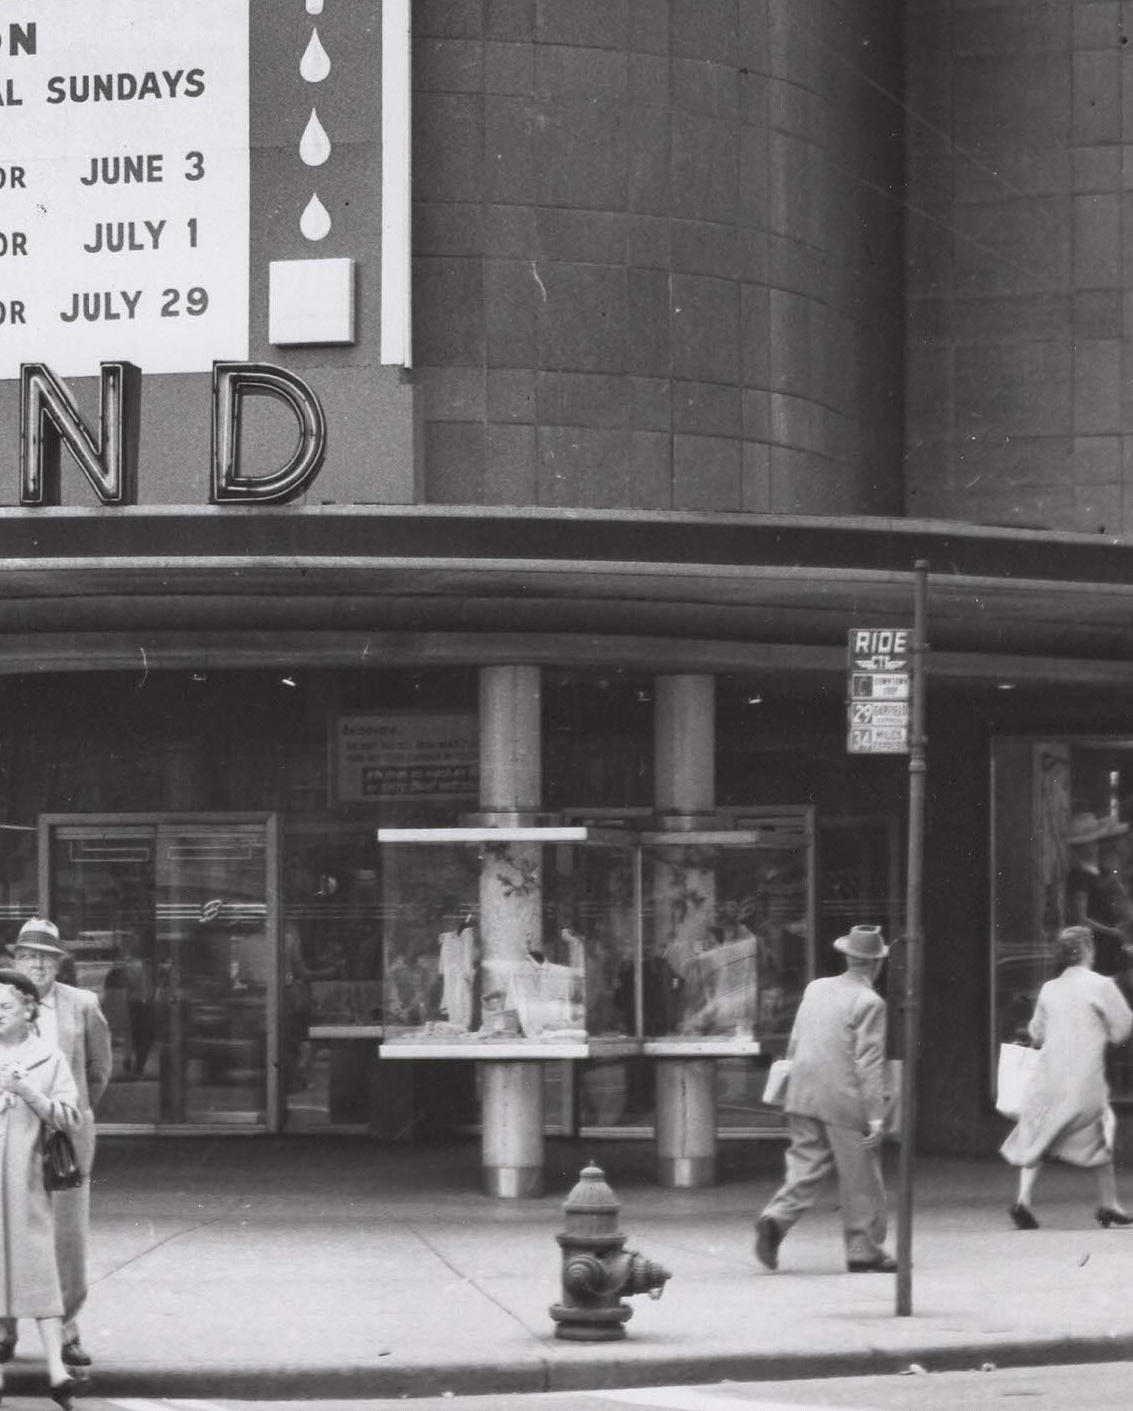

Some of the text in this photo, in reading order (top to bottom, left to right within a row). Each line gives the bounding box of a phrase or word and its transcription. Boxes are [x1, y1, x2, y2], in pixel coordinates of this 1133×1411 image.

[46, 68, 205, 105] SUNDAYS
[80, 154, 163, 186] JUNE
[184, 151, 205, 182] 3
[83, 220, 167, 254] JULY
[187, 218, 197, 248] 1
[60, 290, 143, 323] JULY
[160, 287, 209, 317] 29
[854, 631, 908, 654] RIDE
[853, 703, 873, 724] 29
